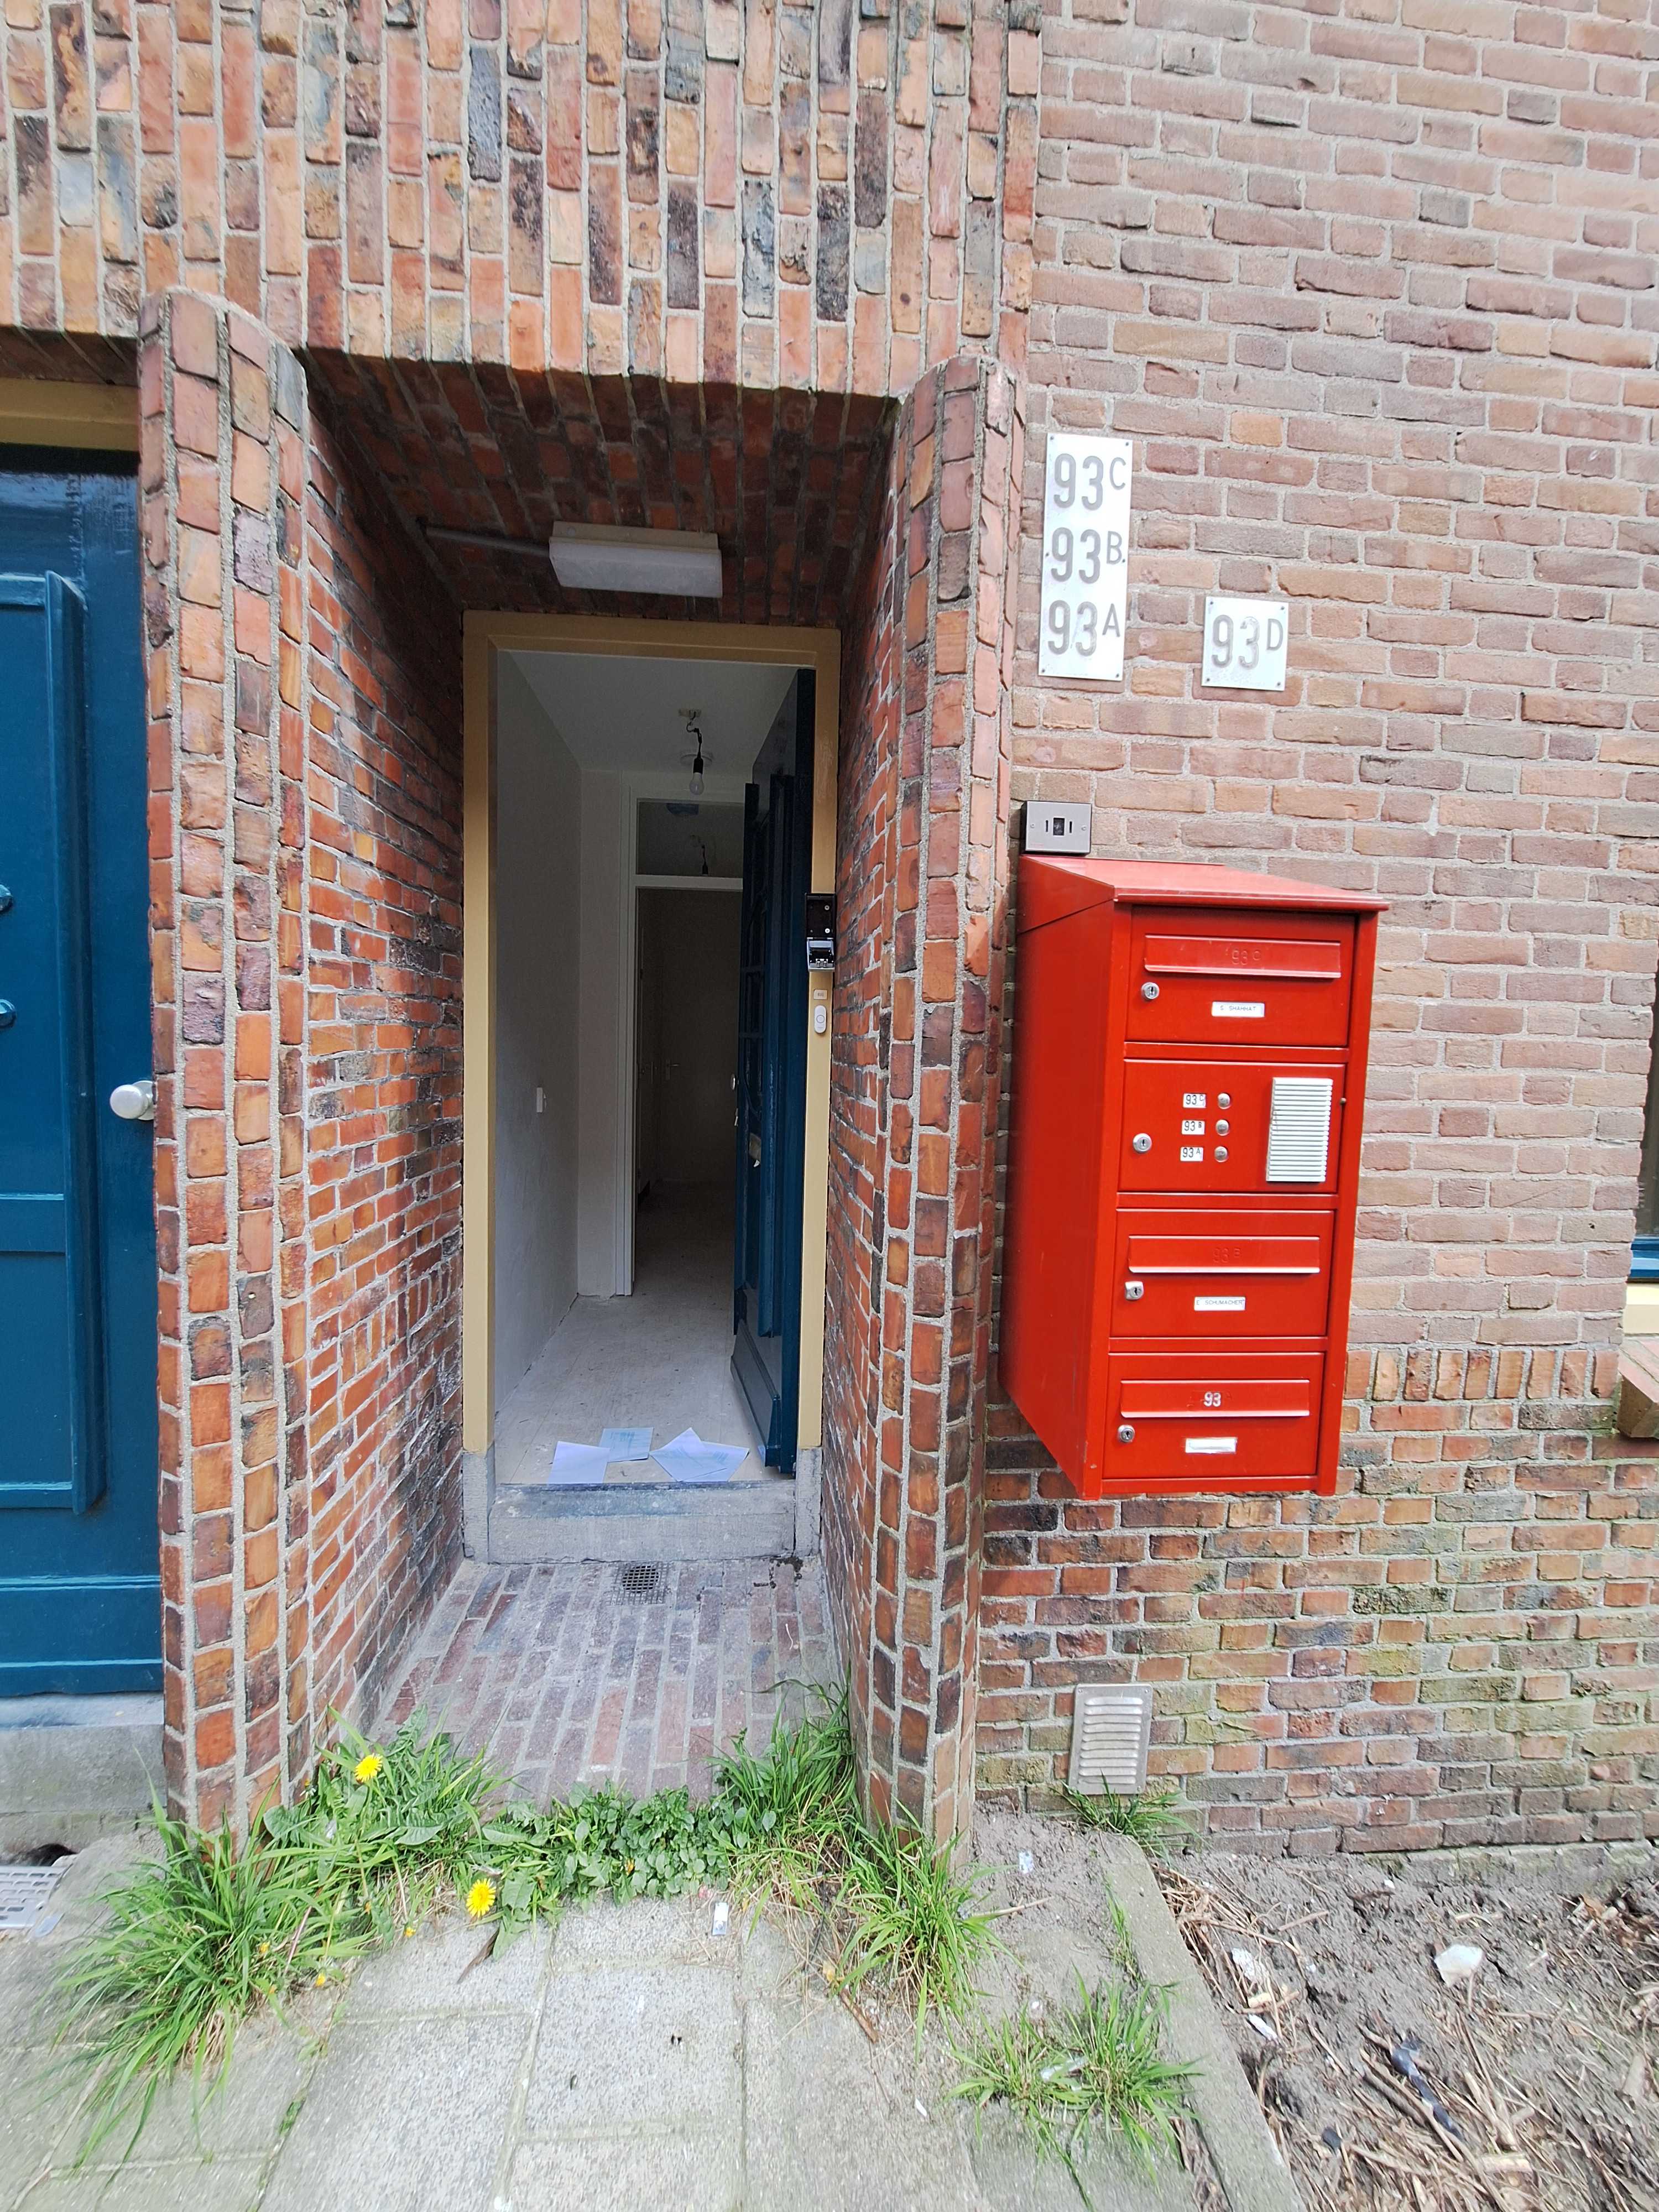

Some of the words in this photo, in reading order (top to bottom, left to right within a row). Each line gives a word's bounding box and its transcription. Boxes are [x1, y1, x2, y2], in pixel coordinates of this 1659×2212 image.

[1053, 453, 1127, 511] 93C
[1050, 526, 1123, 585] 93B
[1047, 599, 1121, 658] 93A
[1211, 614, 1285, 670] 93D
